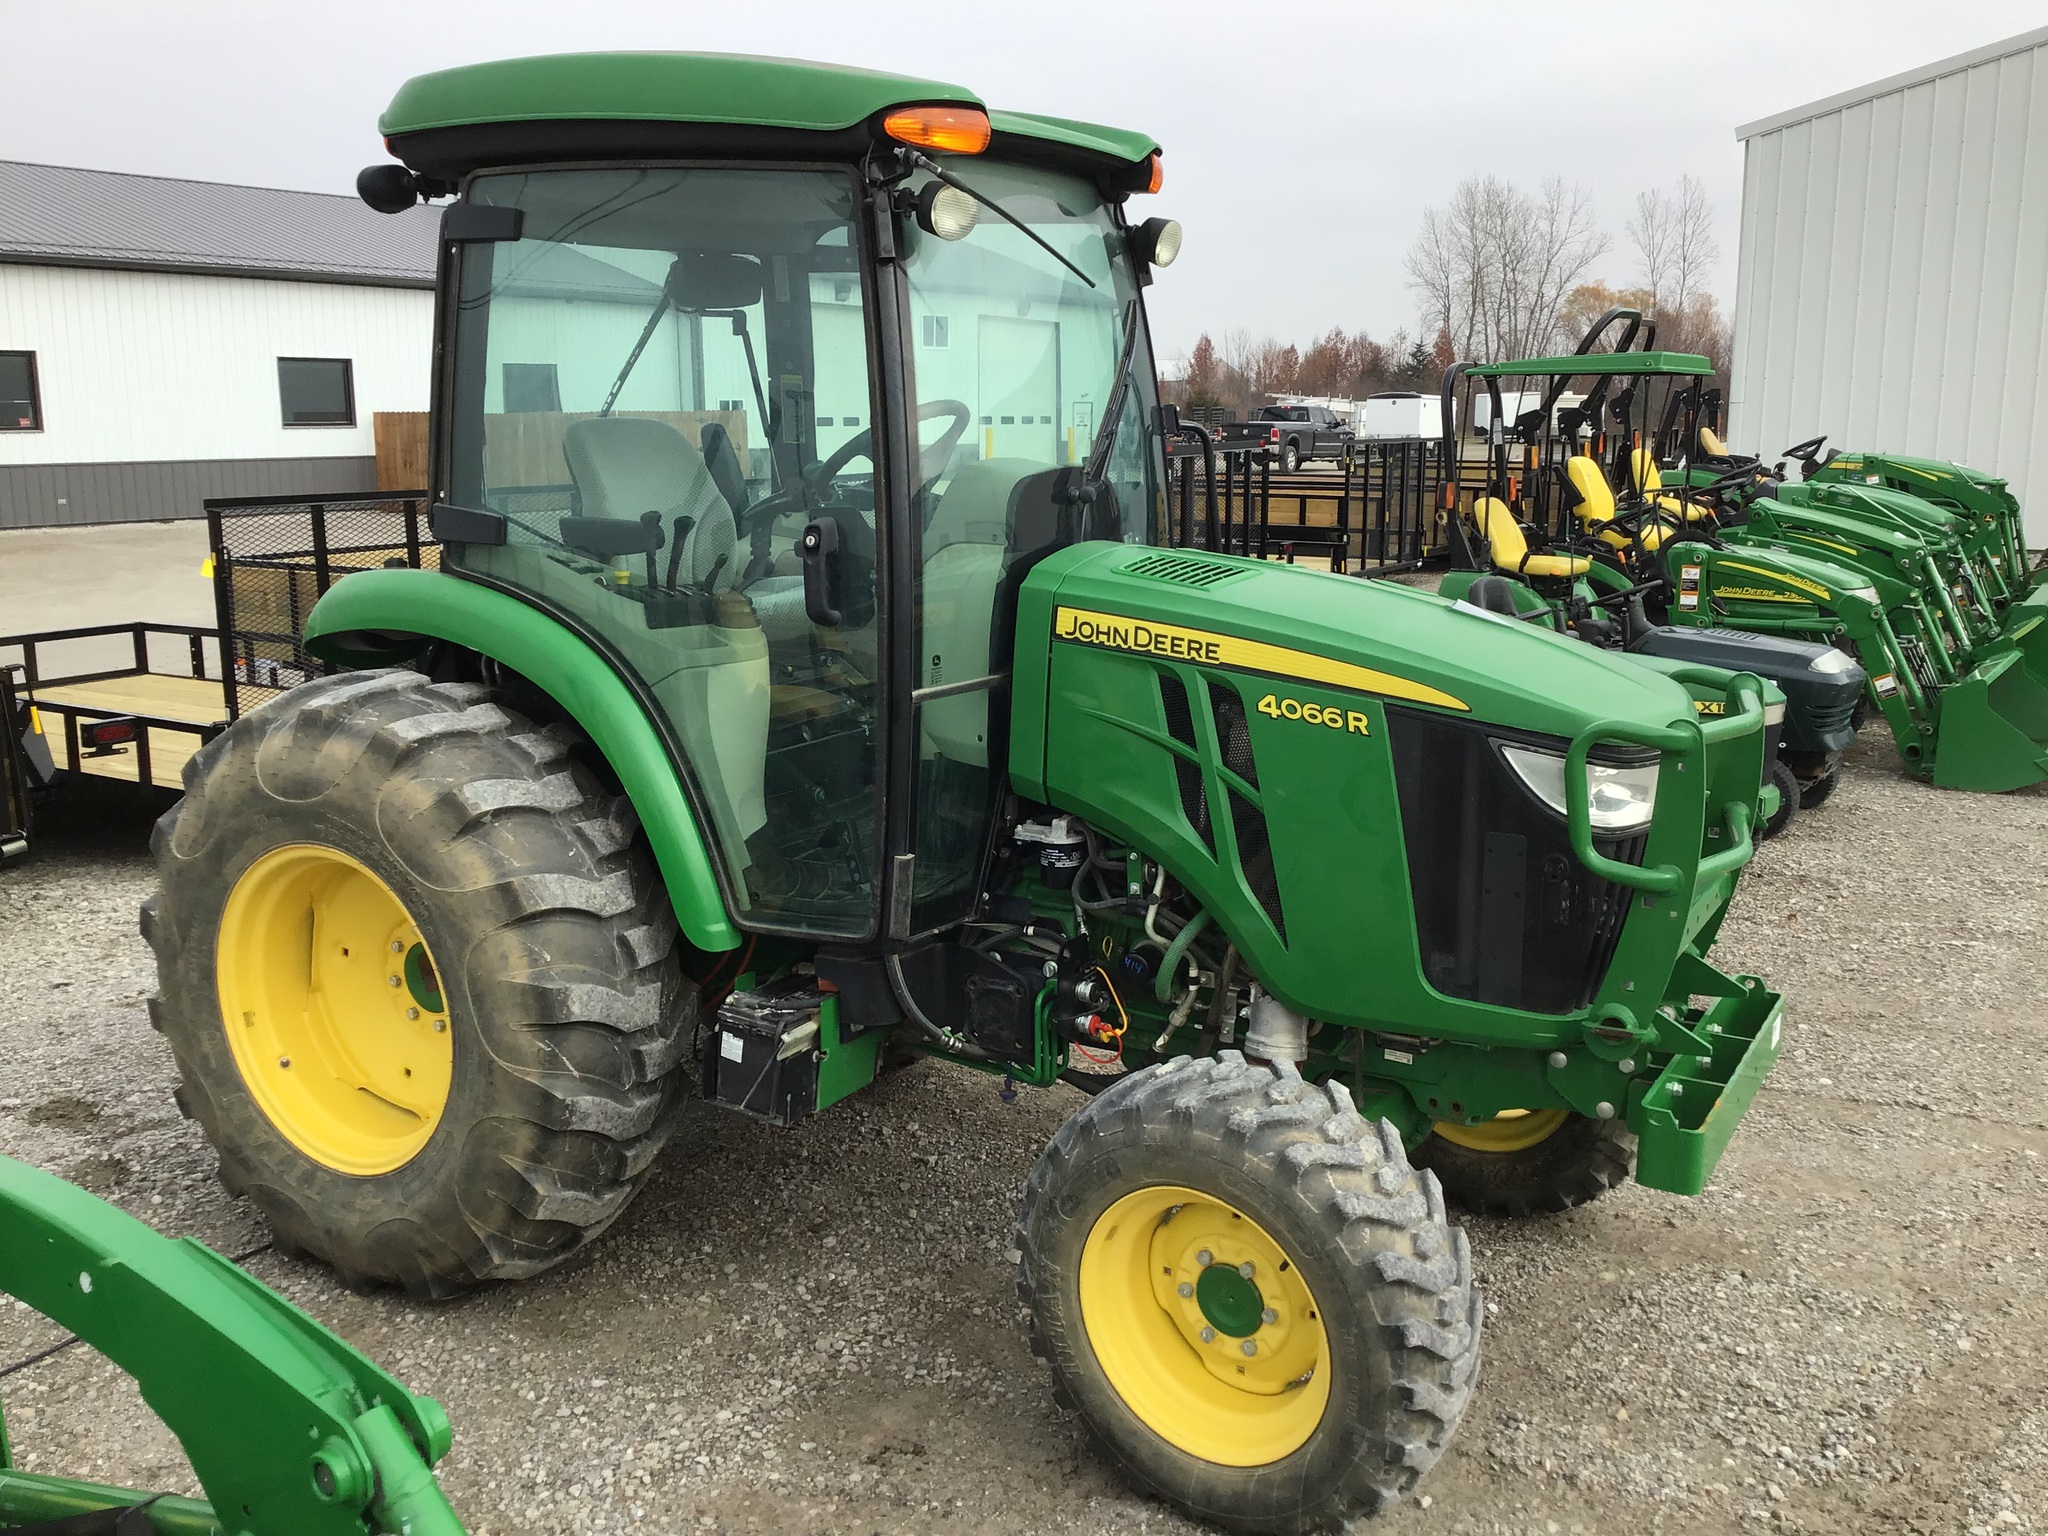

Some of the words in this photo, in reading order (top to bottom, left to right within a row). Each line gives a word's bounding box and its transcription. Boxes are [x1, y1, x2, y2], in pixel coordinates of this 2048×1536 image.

[1719, 585, 1742, 593] JOHN
[1742, 586, 1775, 597] DEERE
[1802, 579, 1826, 592] DEERE
[1065, 616, 1129, 646] JOHN
[1133, 626, 1221, 662] DEERE
